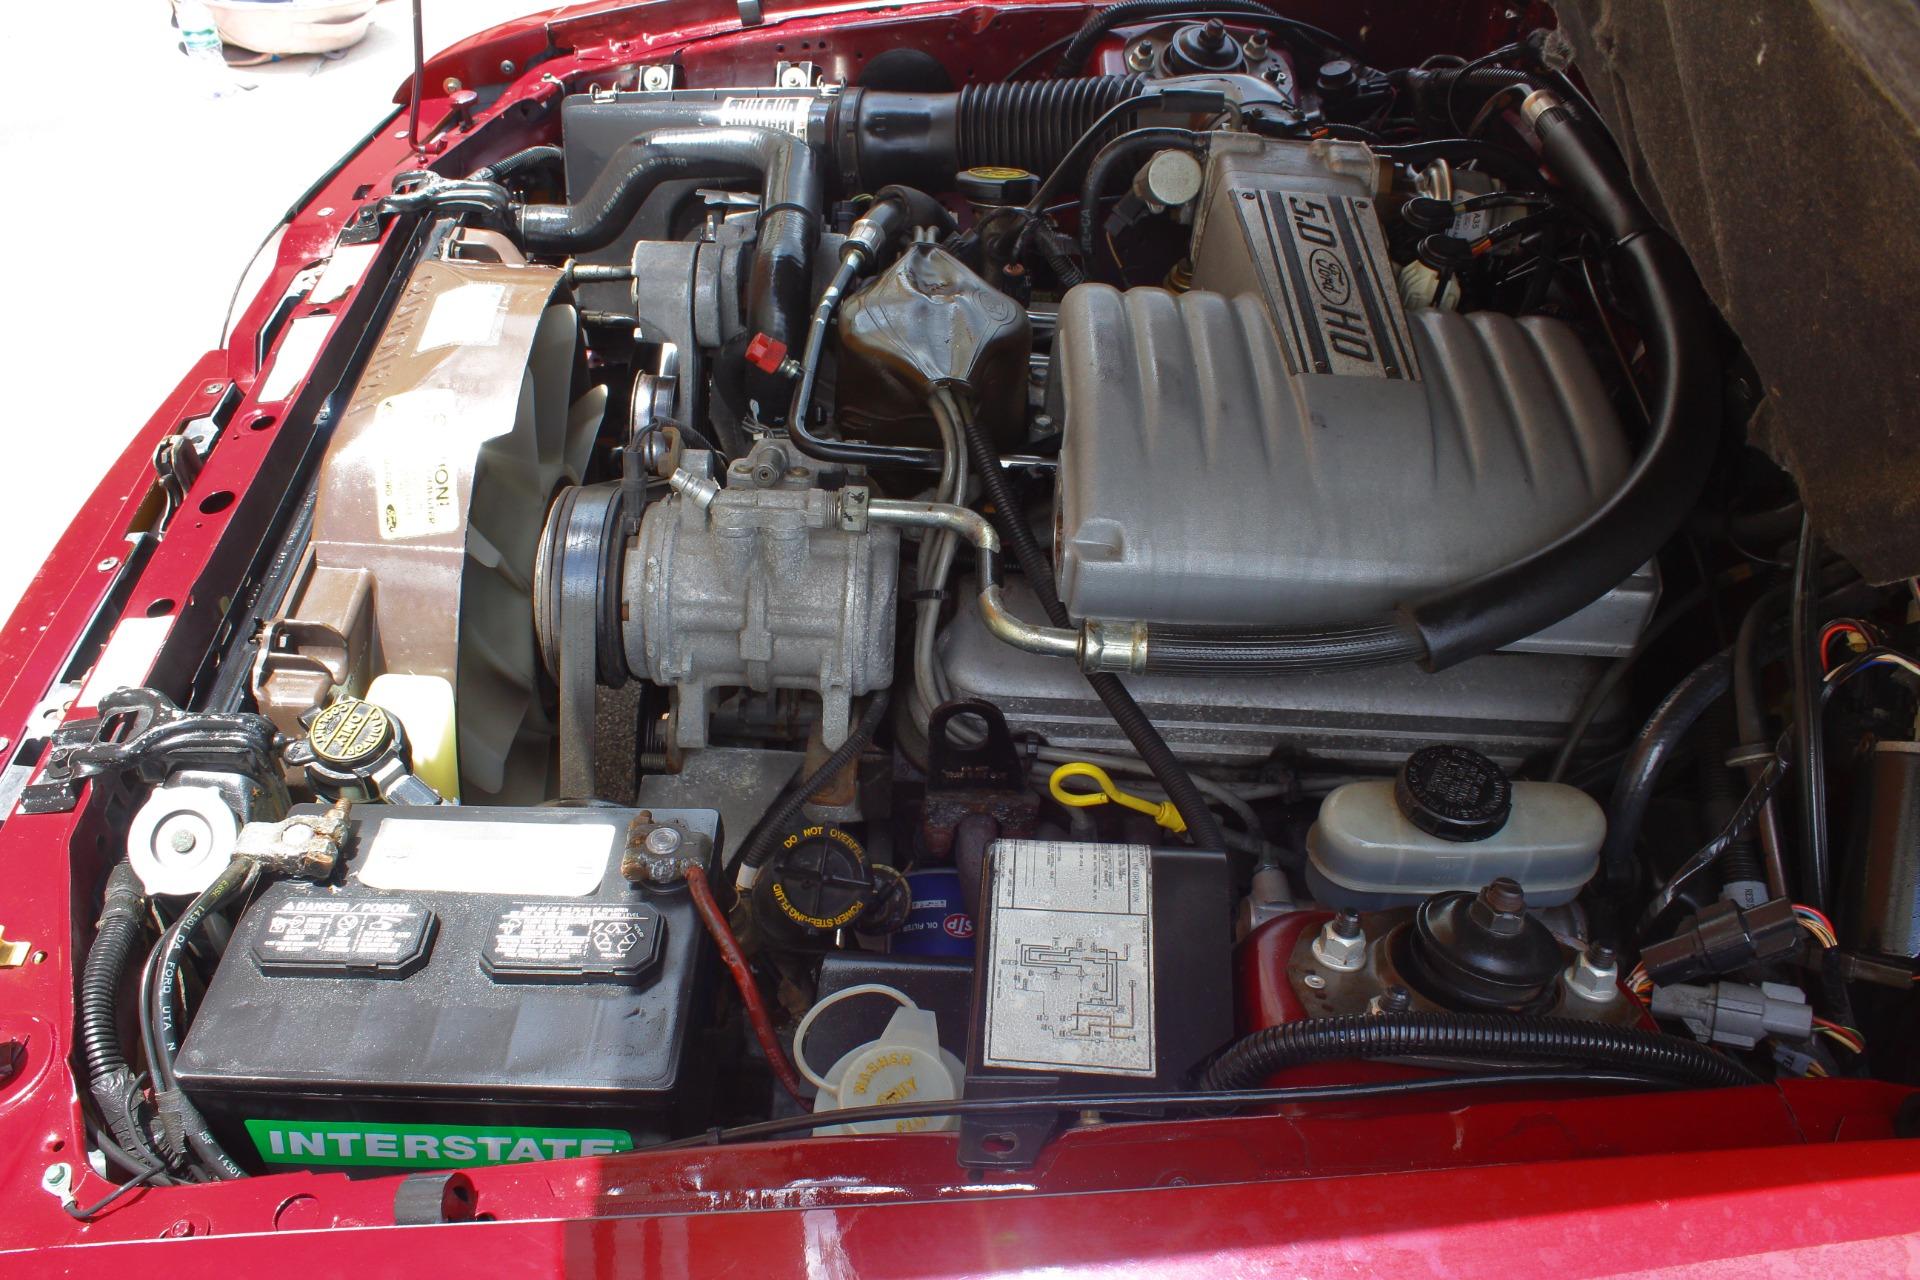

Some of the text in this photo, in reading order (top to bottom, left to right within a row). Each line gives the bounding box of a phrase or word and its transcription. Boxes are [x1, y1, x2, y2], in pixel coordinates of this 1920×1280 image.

[1290, 197, 1337, 248] 5.0
[1320, 303, 1374, 362] HO
[314, 703, 350, 745] COOLANT
[337, 714, 363, 748] ONLY
[346, 713, 384, 756] RADIATOR
[783, 826, 866, 864] DO NOT OVERFILL
[294, 902, 349, 912] DANGER
[360, 903, 411, 912] POISON
[772, 883, 792, 911] FLUID
[834, 900, 865, 926] POWER
[926, 921, 938, 929] OIL
[946, 917, 973, 935] STP
[174, 934, 185, 950] DA
[162, 961, 176, 994] FORD
[162, 1006, 172, 1031] UTA
[269, 1131, 615, 1161] INTERSTATE
[217, 1154, 241, 1178] 14301
